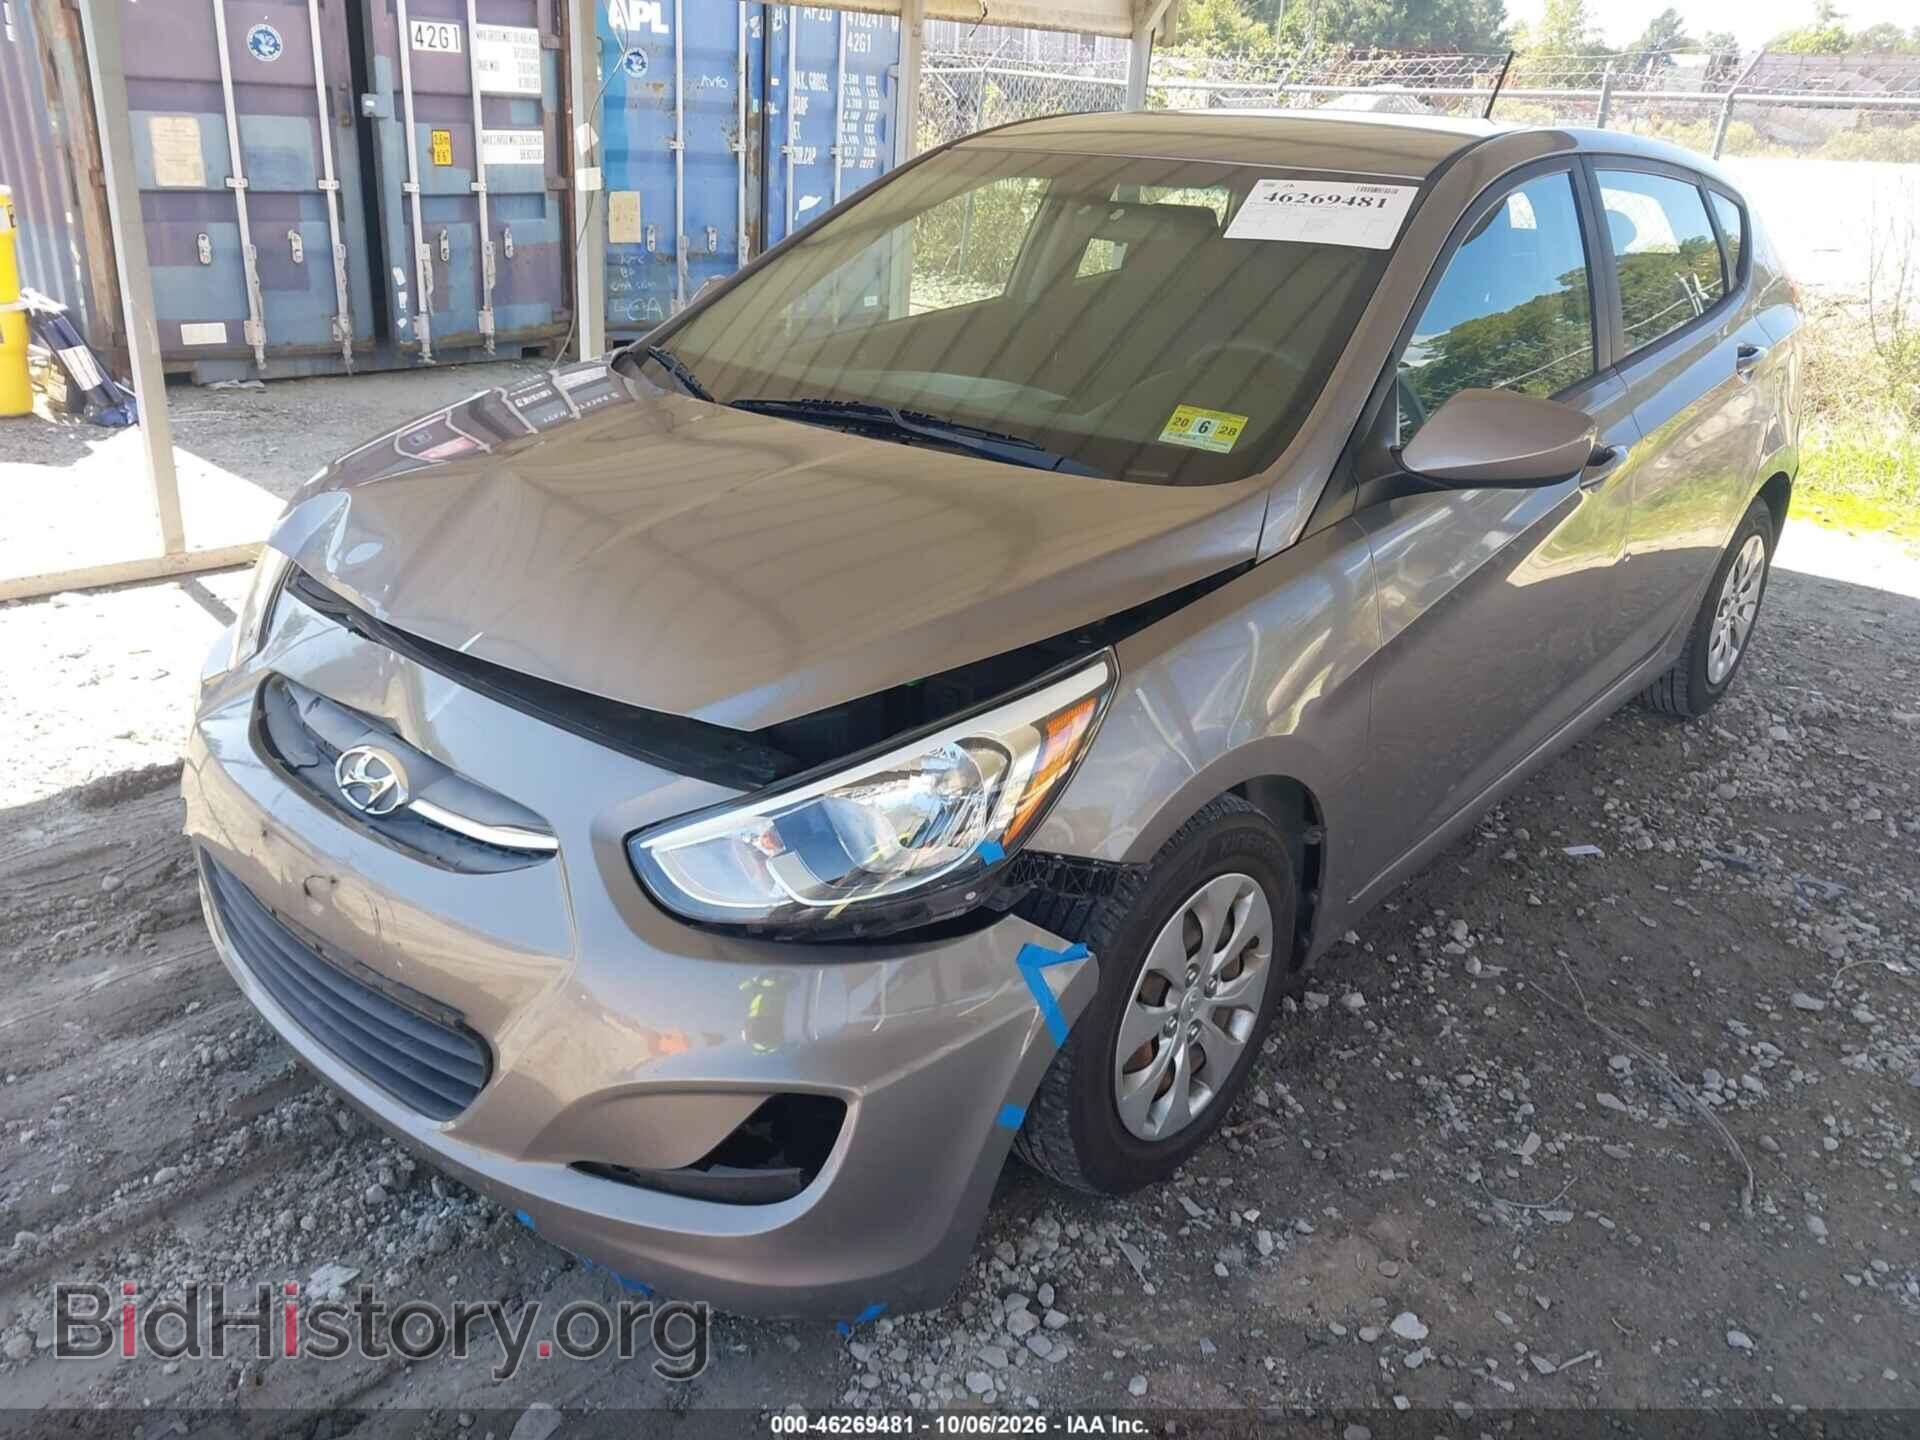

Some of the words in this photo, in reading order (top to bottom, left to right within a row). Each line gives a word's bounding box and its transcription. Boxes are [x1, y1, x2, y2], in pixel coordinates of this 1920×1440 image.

[608, 0, 670, 34] APL
[414, 23, 461, 50] 42G1
[847, 32, 872, 54] 42G1
[1263, 191, 1388, 209] 46269481
[1173, 416, 1190, 428] 20
[1198, 420, 1211, 434] 6
